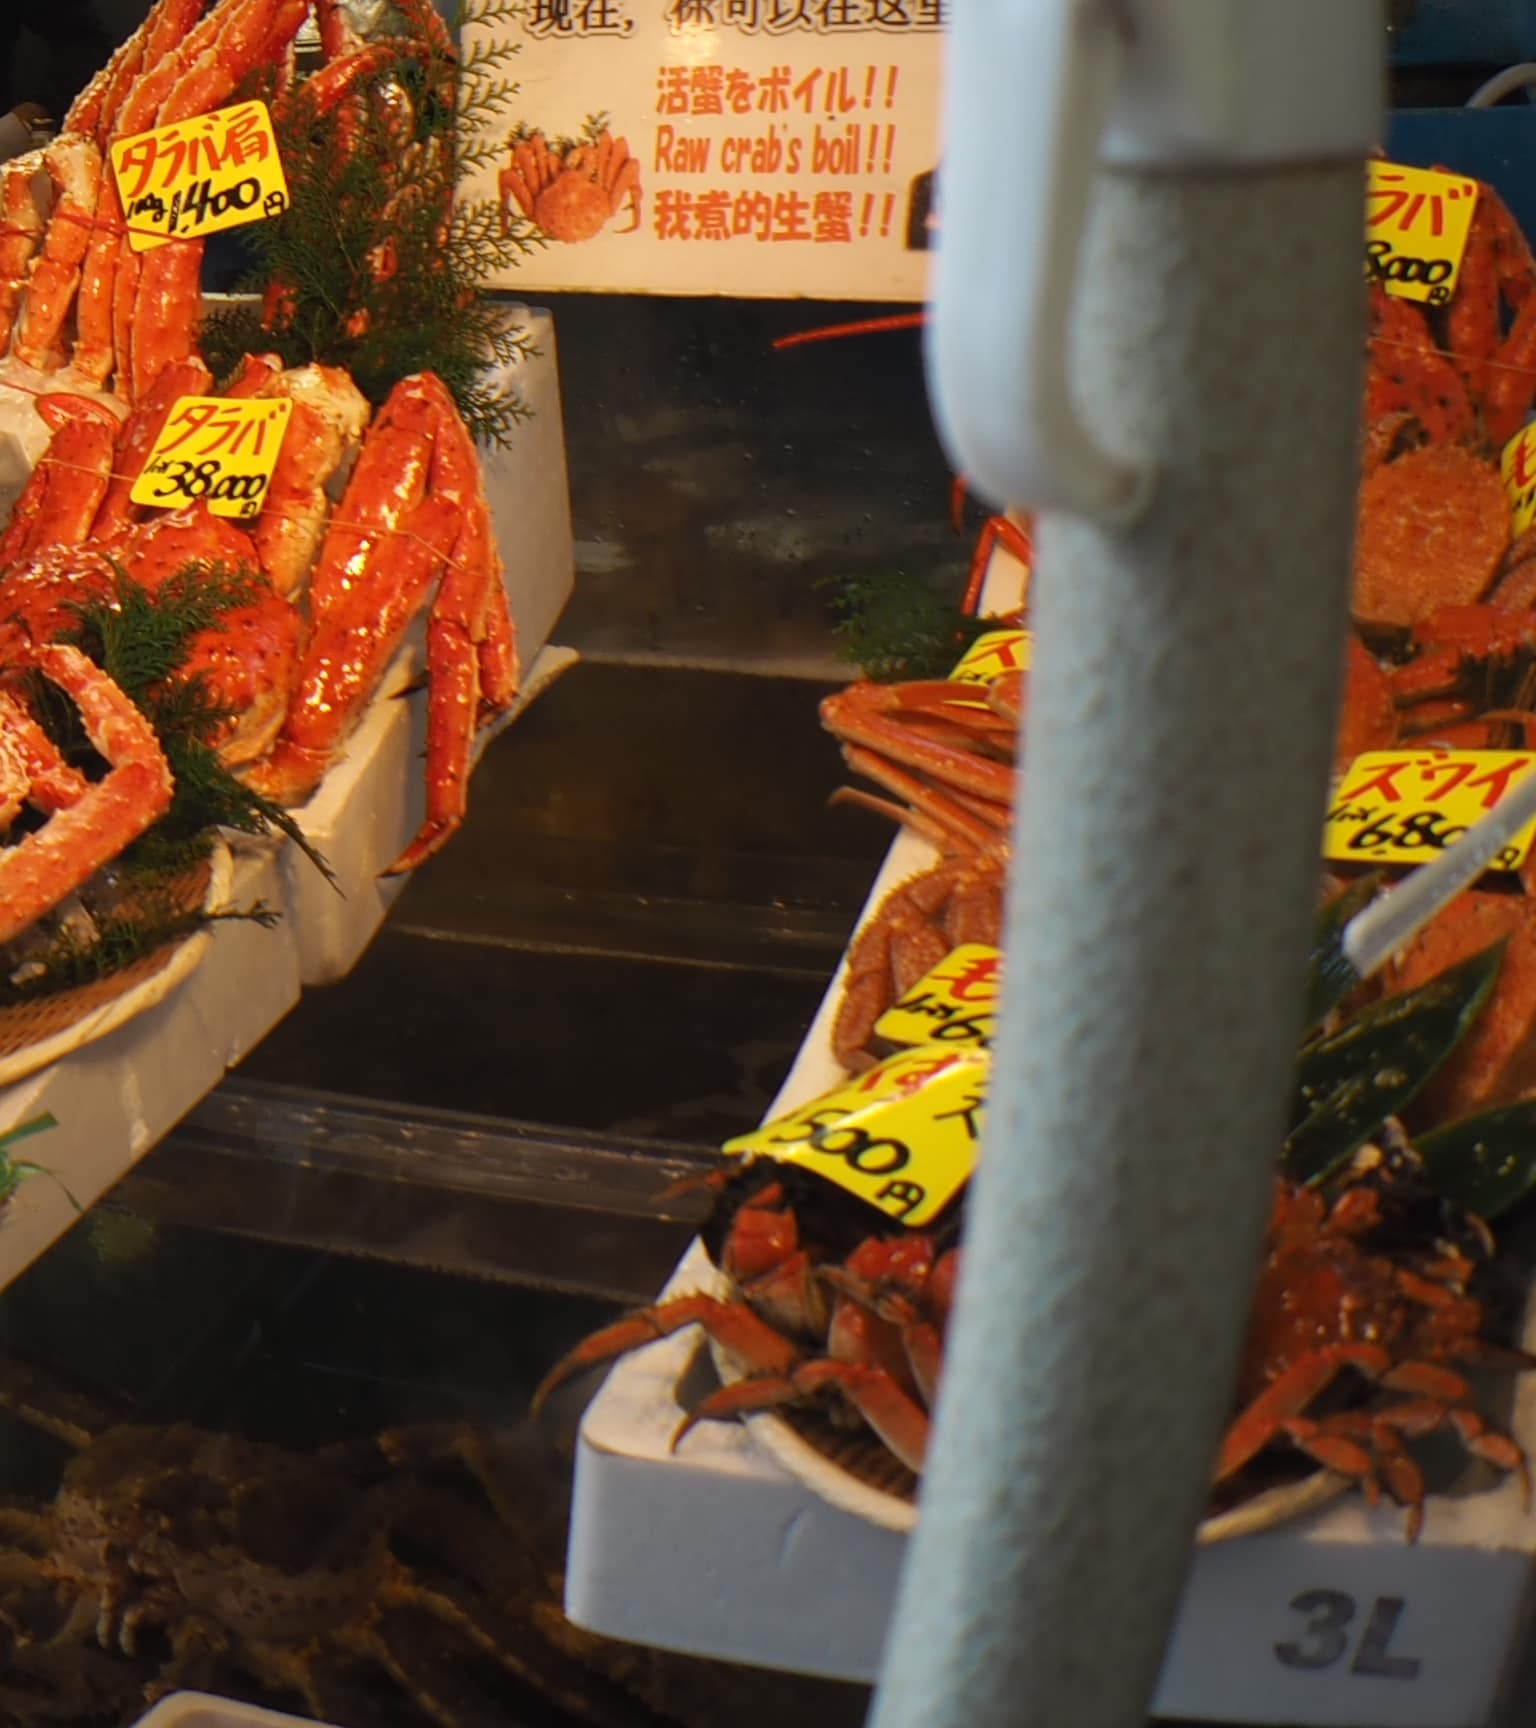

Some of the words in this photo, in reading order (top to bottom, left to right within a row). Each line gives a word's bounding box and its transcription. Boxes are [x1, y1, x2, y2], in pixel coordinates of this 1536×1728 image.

[654, 125, 710, 174] Raw
[720, 125, 803, 174] crab's
[155, 403, 287, 455] タラバ
[1273, 1587, 1421, 1680] 3L
